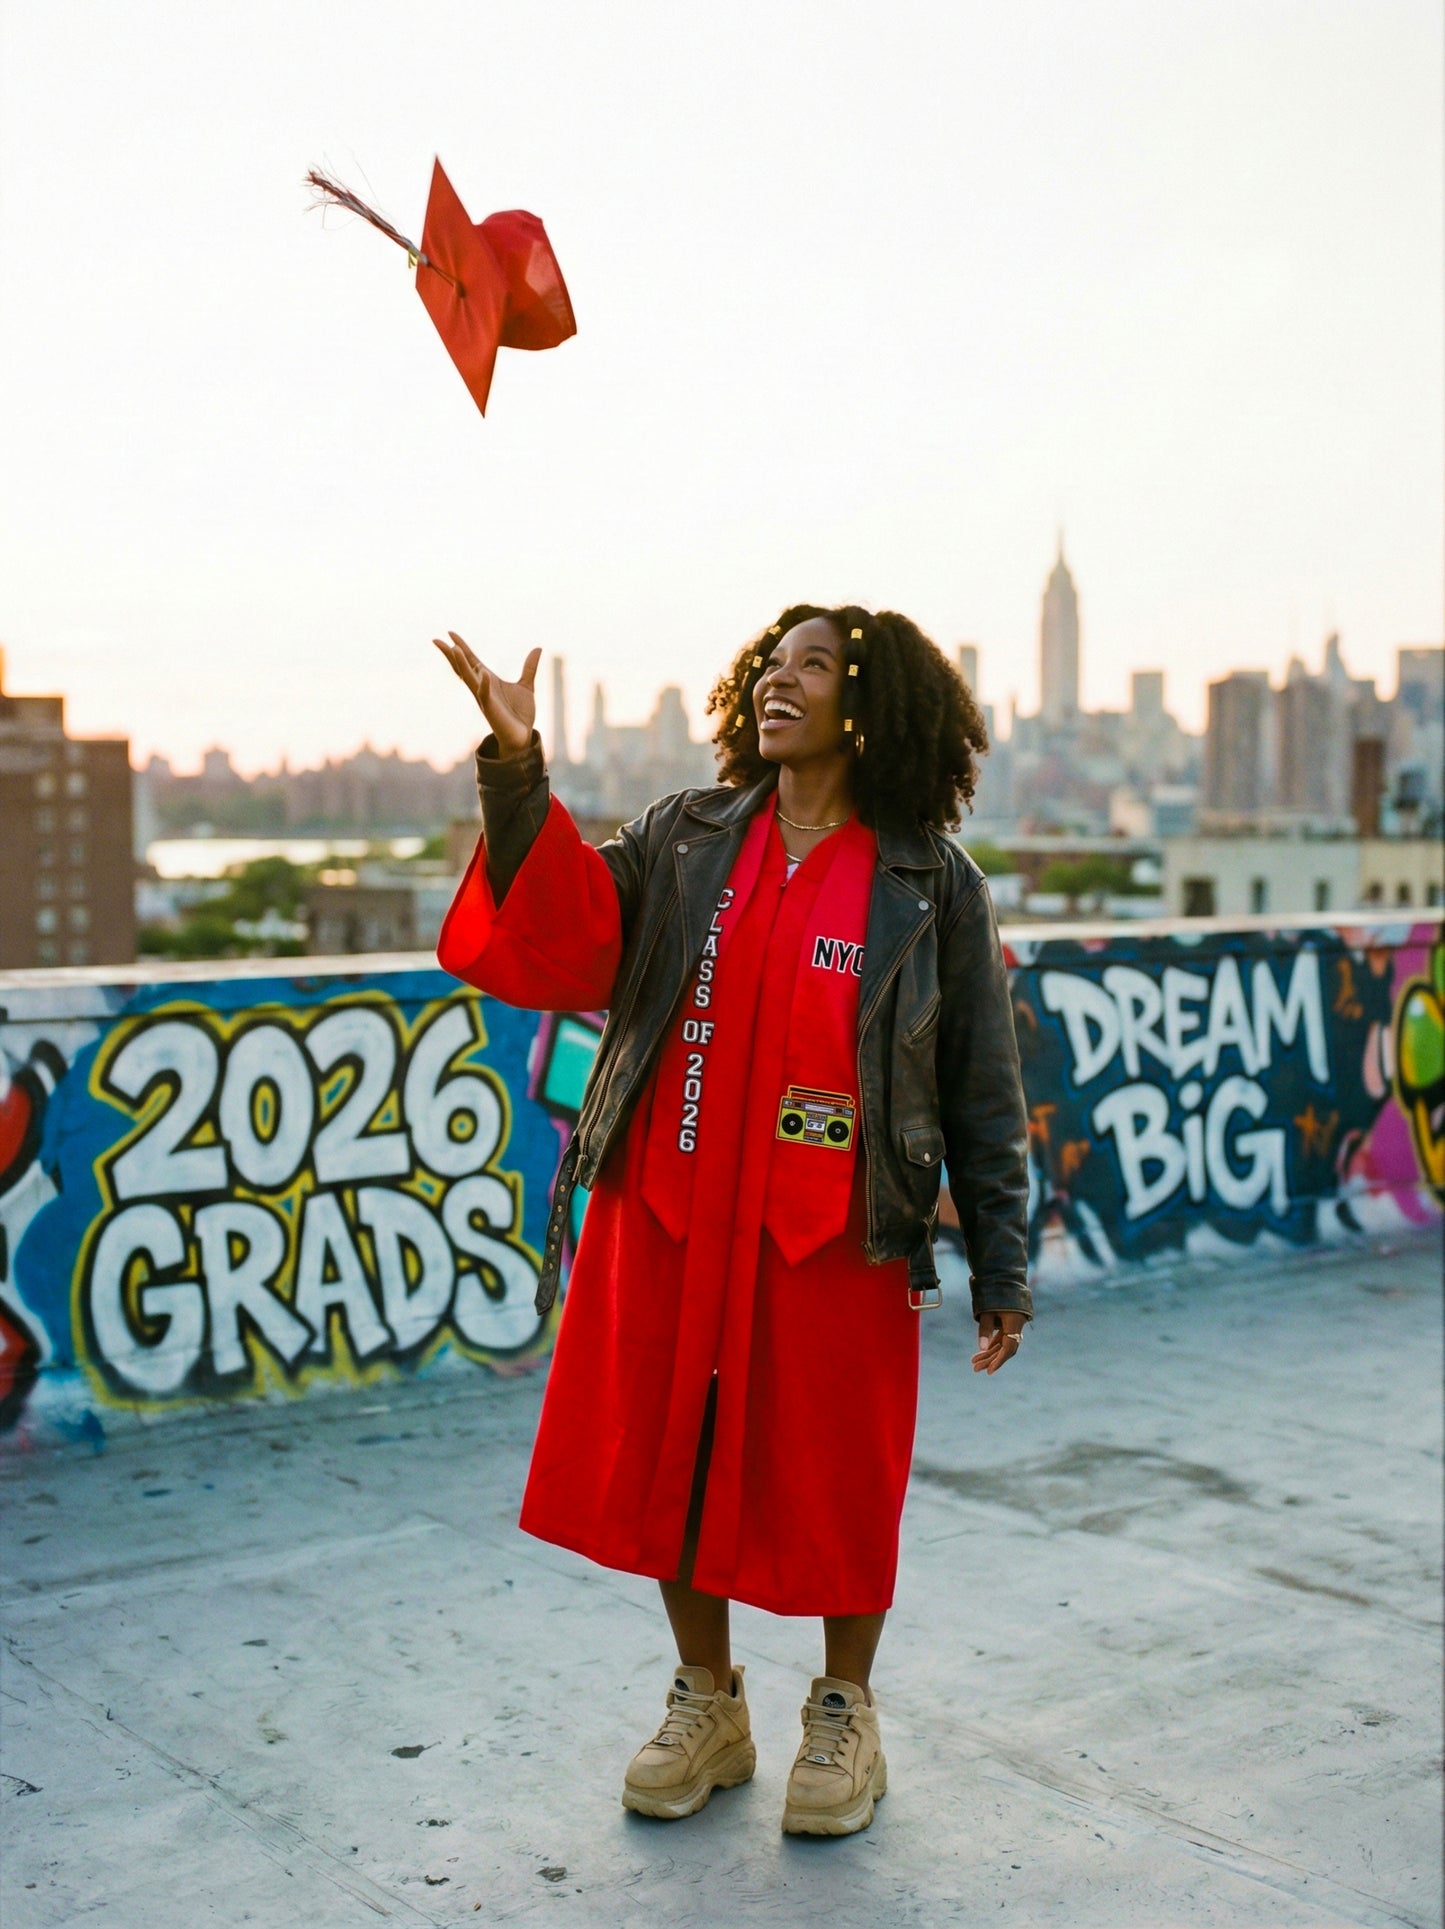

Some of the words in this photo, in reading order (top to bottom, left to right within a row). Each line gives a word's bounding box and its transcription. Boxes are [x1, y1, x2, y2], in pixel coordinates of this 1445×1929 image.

[693, 888, 735, 1009] CLASS
[682, 1019, 715, 1045] OF
[1039, 950, 1331, 1087] DREAM
[105, 1002, 503, 1201] 2026
[677, 1052, 704, 1152] 2026
[89, 1173, 542, 1394] GRADS
